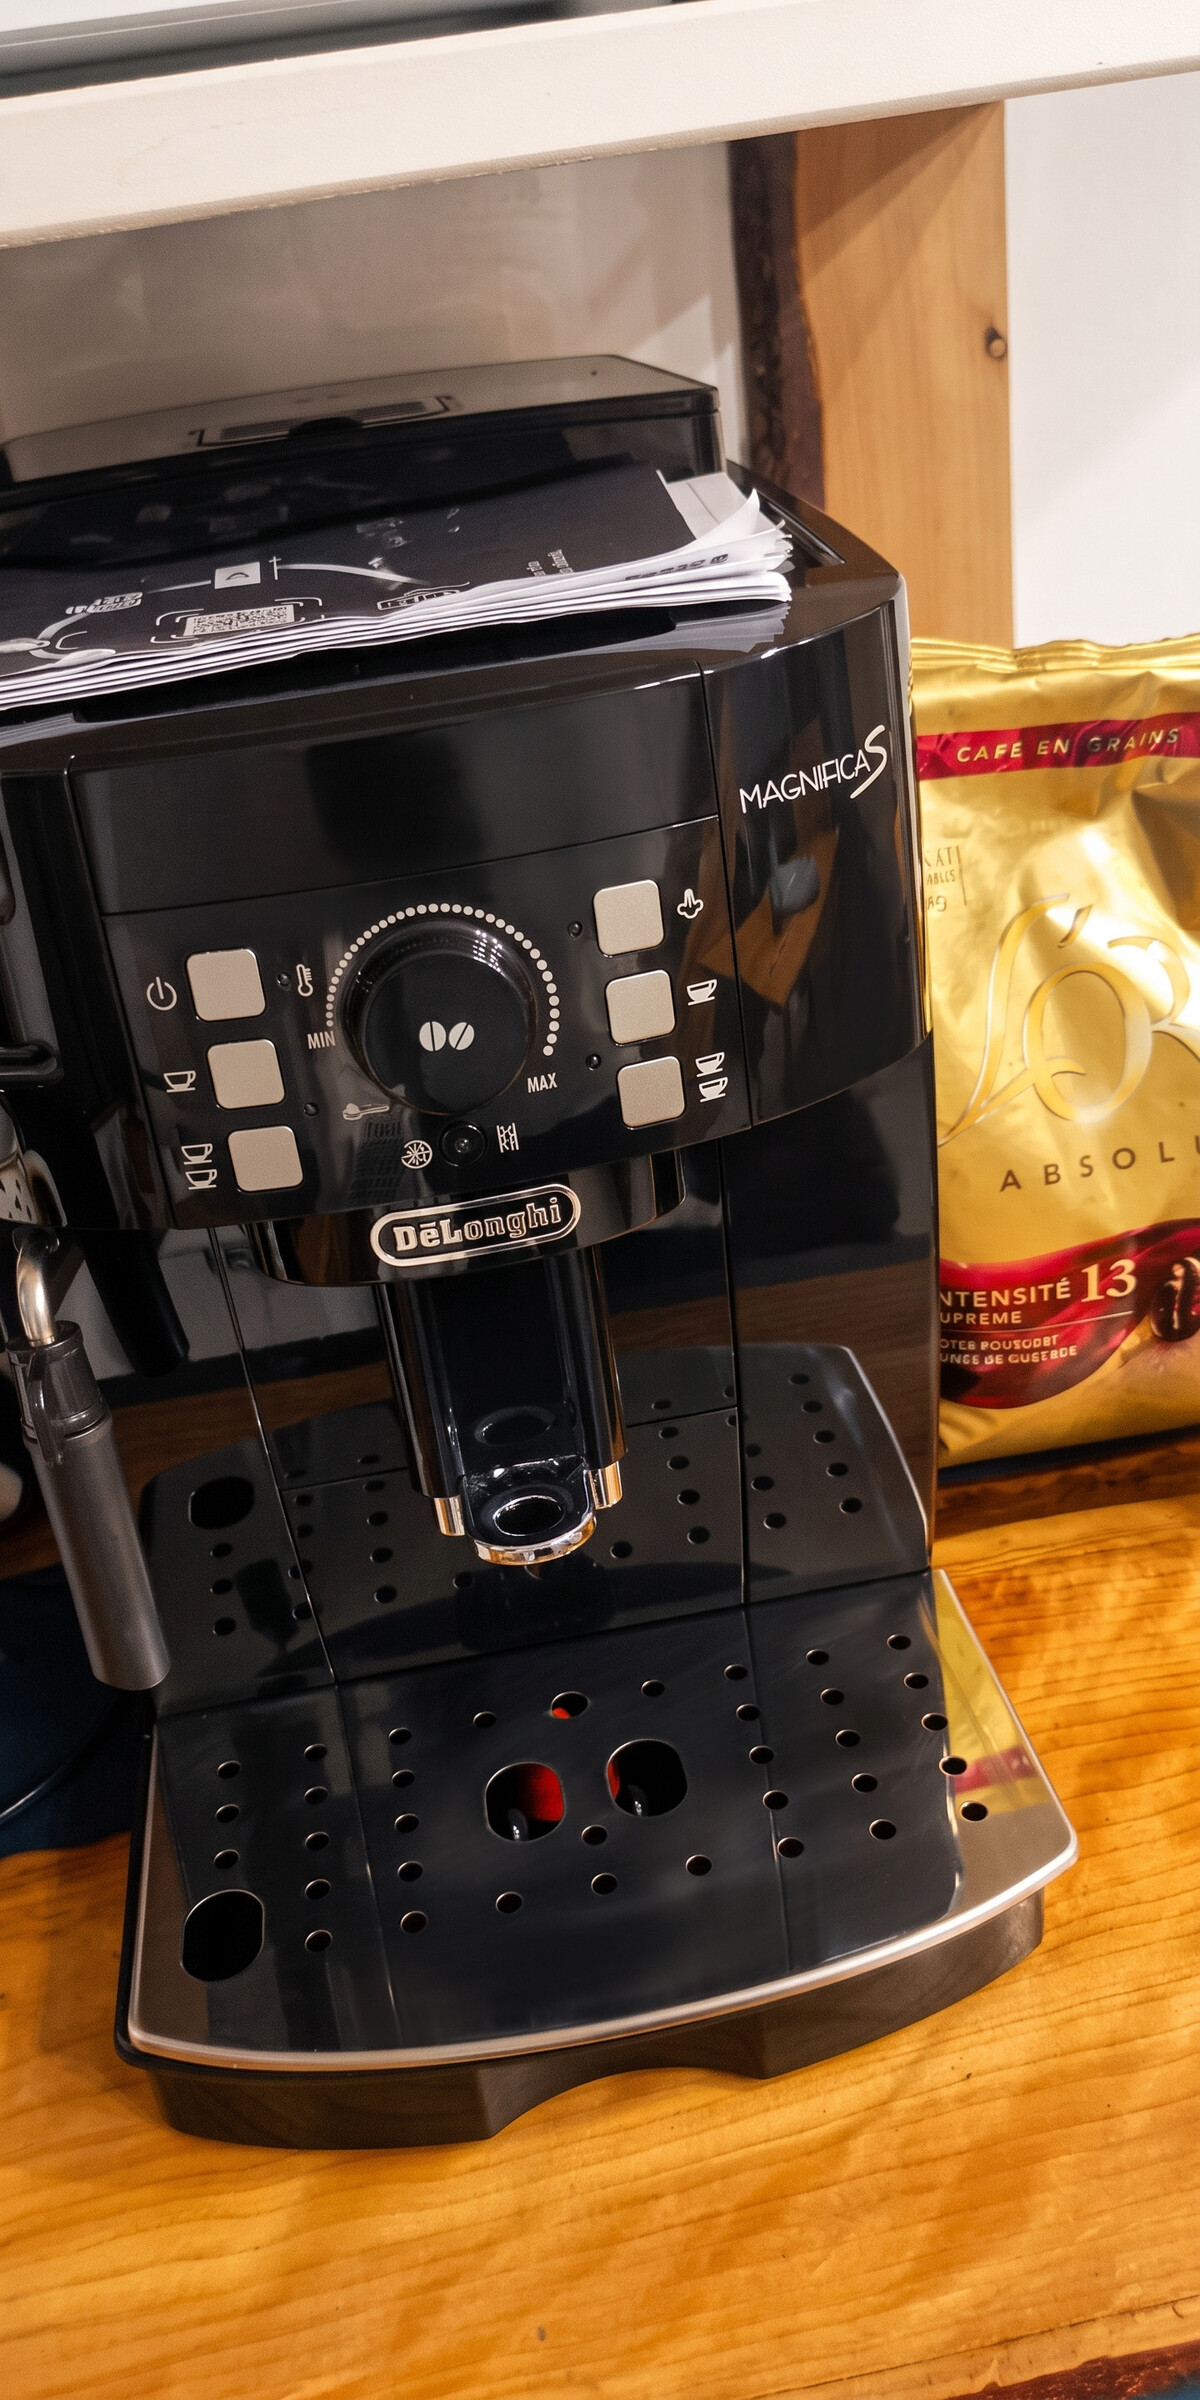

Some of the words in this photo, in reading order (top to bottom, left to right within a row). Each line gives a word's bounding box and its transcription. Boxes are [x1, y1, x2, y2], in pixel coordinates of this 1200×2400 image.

[1037, 739, 1069, 755] EN
[1087, 728, 1179, 753] GRAINS
[307, 1030, 336, 1050] MIN
[527, 1072, 558, 1094] MAX
[1080, 1258, 1137, 1303] 13
